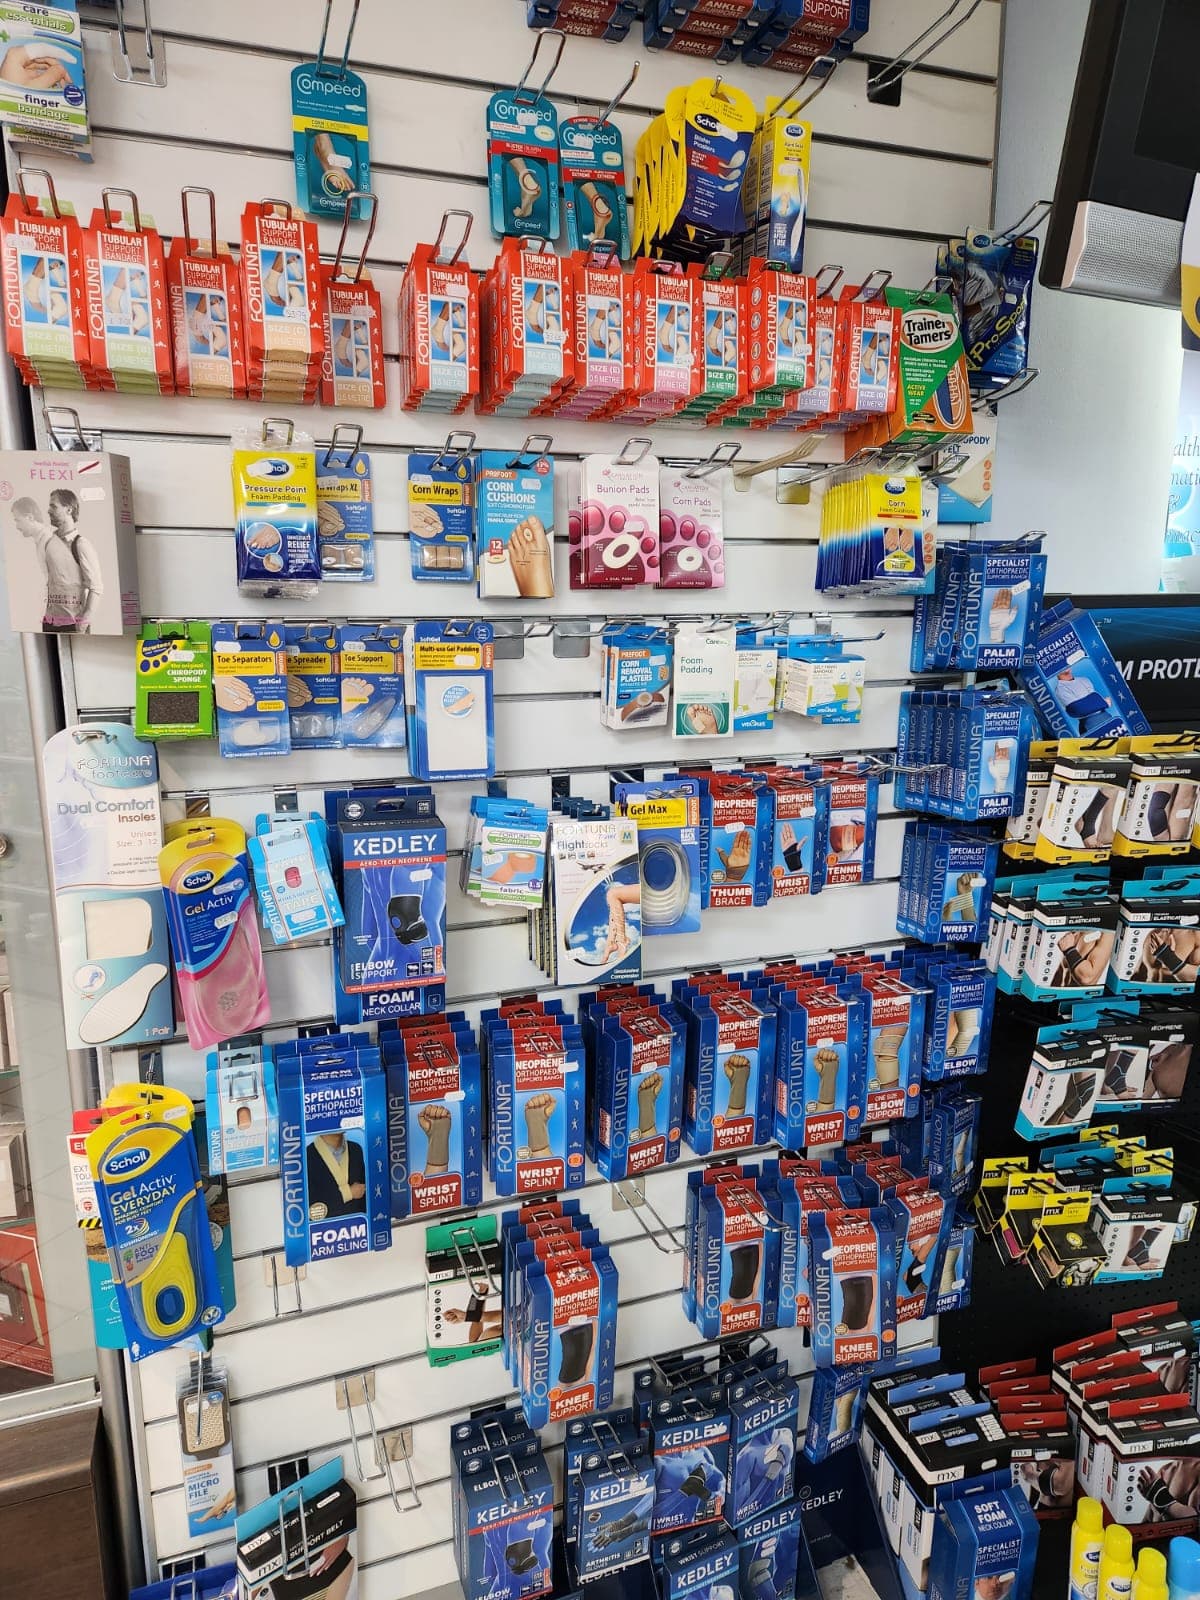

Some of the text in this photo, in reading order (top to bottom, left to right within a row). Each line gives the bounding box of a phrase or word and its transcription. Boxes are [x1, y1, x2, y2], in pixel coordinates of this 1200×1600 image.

[23, 5, 49, 16] care
[5, 12, 67, 31] essentials
[691, 19, 730, 32] ANKLE
[677, 39, 715, 52] ANKLE
[297, 73, 361, 98] Compeed
[24, 94, 60, 108] finger
[18, 103, 70, 121] bandage
[787, 125, 803, 136] Scholl
[20, 222, 61, 236] TUBULAR
[260, 219, 298, 232] TUBULAR
[263, 237, 297, 248] BANDAGE
[105, 252, 142, 263] BANDAGE
[431, 271, 463, 282] TUBULAR
[526, 270, 556, 280] BANDAGE
[659, 277, 689, 289] TUBULAR
[706, 284, 735, 294] TUBULAR
[332, 290, 364, 300] TUBULAR
[590, 287, 618, 297] BANDAGE
[87, 258, 104, 339] FORTUNA
[766, 295, 777, 362] FORTUNA
[904, 317, 947, 333] Trainer
[906, 329, 951, 346] Tamers
[589, 365, 621, 375] SIZE (E)
[707, 371, 736, 382] SIZE (F)
[29, 469, 75, 480] FLEXI
[485, 471, 512, 479] PROFOOT
[245, 485, 307, 494] Pressure Point
[412, 484, 459, 497] Corn Wraps
[486, 481, 514, 492] CORN
[596, 484, 650, 495] Bunion Pads
[486, 493, 536, 504] CUSHIONS
[672, 496, 712, 506] Corn Pads
[888, 499, 906, 508] Corn
[287, 541, 311, 549] RELIEF
[986, 558, 1030, 568] SPECIALIST
[961, 572, 984, 660] FORTUNA
[419, 645, 480, 654] Multi-use Gel Padding
[621, 650, 647, 658] PROFOOT
[983, 648, 1016, 658] PALM
[217, 655, 273, 665] Toe Separators
[293, 656, 327, 667] Spreader
[356, 655, 384, 664] Support
[621, 660, 640, 668] CORN
[680, 656, 704, 665] Foam
[977, 657, 1020, 668] SUPPORT
[620, 667, 653, 677] REMOVAL
[680, 665, 713, 675] Padding
[620, 674, 653, 683] PLASTERS
[985, 711, 1020, 720] SPECIALIST
[76, 755, 151, 770] FORTUNA
[91, 768, 153, 780] footcare
[57, 799, 155, 816] Dual Comfort
[713, 799, 757, 808] NEOPRENE
[982, 798, 1009, 808] PALM
[630, 804, 667, 815] Gel Max
[117, 812, 156, 824] Insoles
[353, 834, 438, 856] KEDLEY
[557, 840, 608, 850] Flightsocks
[950, 847, 985, 855] SPECIALIST
[828, 865, 862, 875] TENNIS
[185, 872, 214, 887] Scholl
[831, 873, 858, 883] ELBOW
[711, 888, 752, 896] THUMB
[773, 886, 809, 897] SUPPORT
[184, 894, 234, 918] Gel Activ
[715, 896, 747, 906] BRACE
[1067, 917, 1101, 925] ELASTICATED
[942, 925, 974, 934] WRIST
[946, 932, 969, 942] WRAP
[355, 959, 395, 972] ELBOW
[369, 990, 415, 1006] FOAM
[362, 1001, 421, 1017] NECK COLLAR
[719, 1018, 760, 1032] NEOPRENE
[808, 1012, 847, 1026] NEOPRENE
[808, 1022, 847, 1034] ORTHOPAEDIC
[719, 1029, 759, 1040] ORTHOPAEDIC
[515, 1057, 564, 1070] NEOPRENE
[944, 1058, 977, 1070] ELBOW
[950, 1067, 971, 1076] WRAP
[304, 1086, 363, 1103] SPECIALIST
[304, 1097, 364, 1114] ORTHOPAEDIC
[867, 1099, 905, 1112] ELBOW
[305, 1107, 364, 1121] SUPPORTS RANGE
[807, 1119, 843, 1133] WRIST
[719, 1134, 749, 1147] SPLINT
[810, 1130, 838, 1143] SPLINT
[629, 1143, 664, 1162] WRIST
[110, 1150, 148, 1173] Scholl
[632, 1155, 660, 1171] SPLINT
[519, 1166, 562, 1179] WRIST
[283, 1124, 305, 1238] FORTUNA
[524, 1177, 559, 1189] SPLINT
[110, 1173, 174, 1206] Gel Activ
[414, 1182, 459, 1198] WRIST
[112, 1184, 177, 1217] EVERYDAY
[114, 1199, 165, 1222] AMAZING COMFORT
[1045, 1208, 1060, 1216] mx
[311, 1223, 367, 1246] FOAM
[135, 1245, 160, 1260] FOOT
[311, 1239, 368, 1258] ARM SLING
[553, 1288, 600, 1306] NEOPRENE
[936, 1295, 957, 1306] KNEE
[553, 1298, 600, 1315] ORTHOPAEDIC
[896, 1299, 925, 1315] ANKLE
[726, 1310, 757, 1324] KNEE
[721, 1318, 761, 1332] SUPPORT
[840, 1343, 873, 1353] KNEE
[1155, 1341, 1182, 1351] UNIVERSAL
[835, 1350, 878, 1362] SUPPORT
[532, 1320, 550, 1408] FORTUNA
[555, 1391, 590, 1409] KNEE
[550, 1400, 594, 1420] SUPPORT
[744, 1395, 794, 1432] KEDLEY
[937, 1470, 958, 1483] mx
[188, 1477, 220, 1492] MICRO
[189, 1488, 209, 1500] FILE
[801, 1488, 844, 1512] KEDLEY
[974, 1501, 1000, 1514] SOFT
[978, 1510, 1007, 1523] FOAM
[744, 1507, 798, 1540] KEDLEY
[978, 1519, 1014, 1531] NECK COLLAR
[978, 1539, 1021, 1554] SPECIALIST
[585, 1552, 622, 1568] ARTHRITIS
[677, 1552, 734, 1589] KEDLEY
